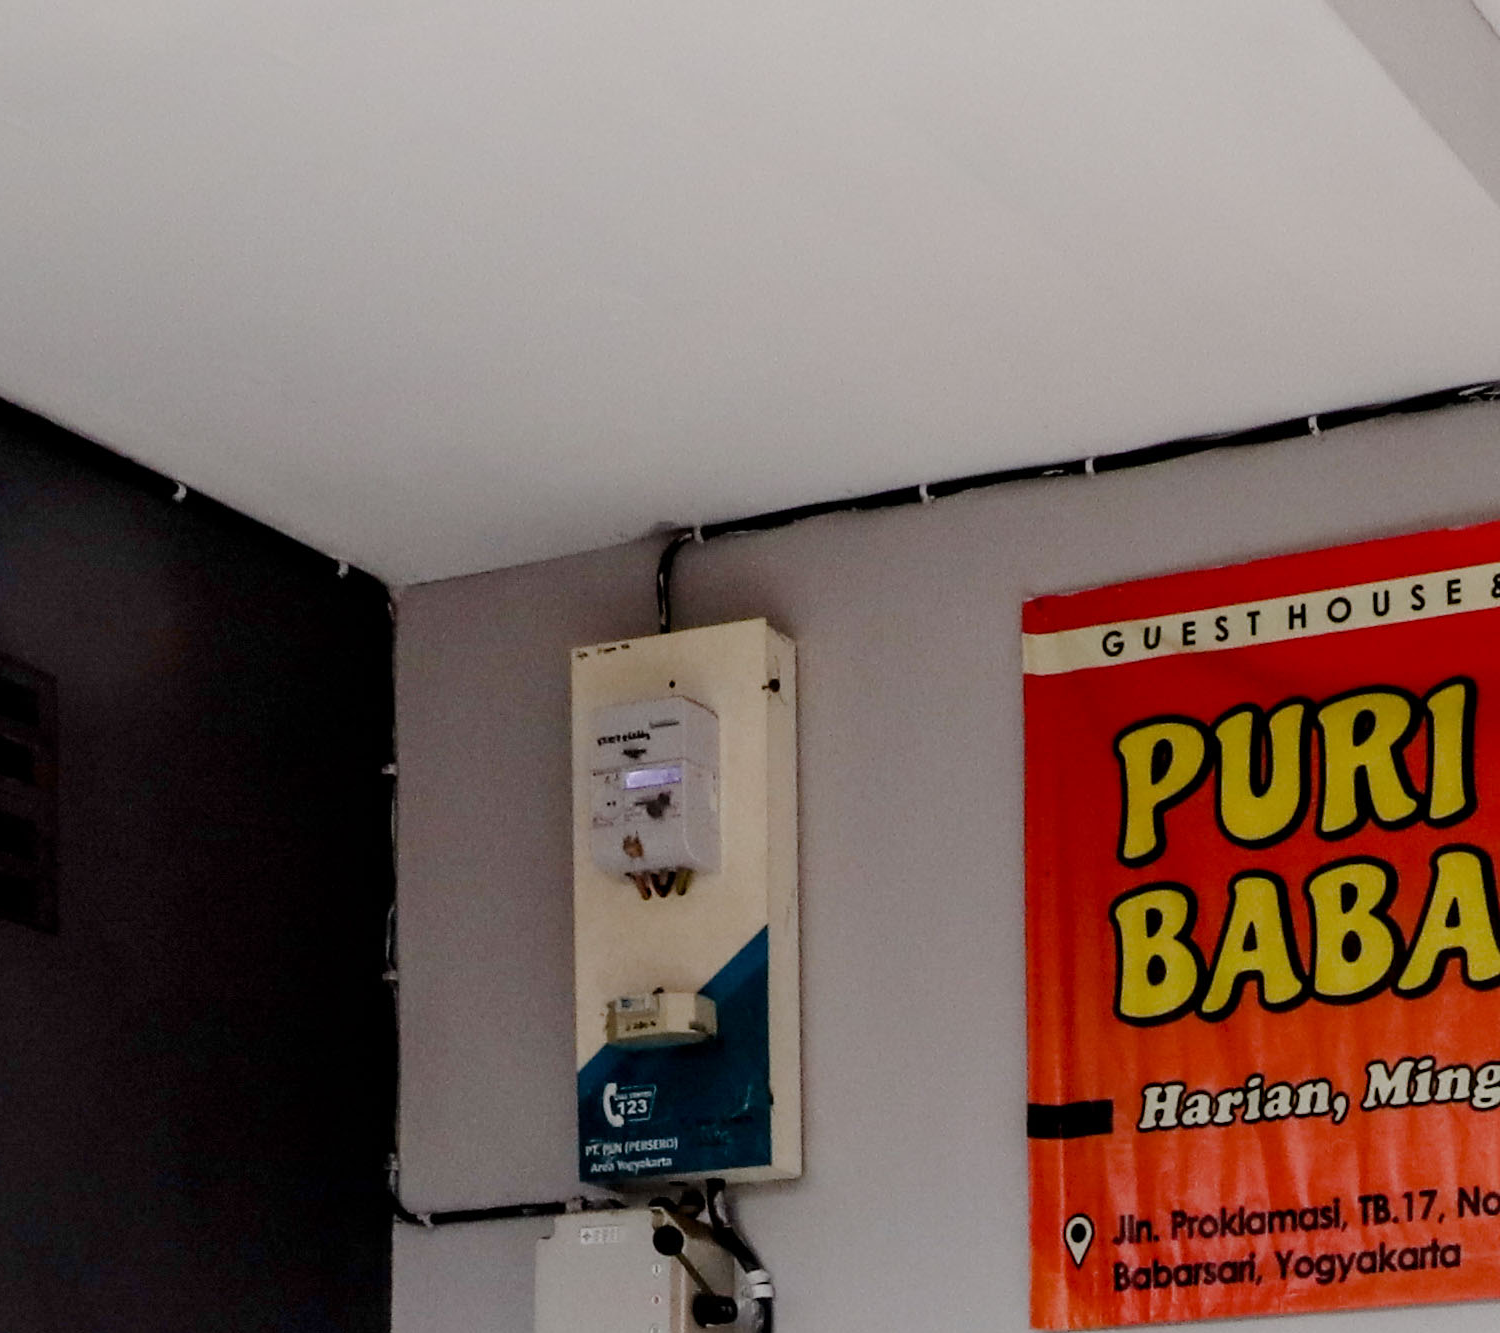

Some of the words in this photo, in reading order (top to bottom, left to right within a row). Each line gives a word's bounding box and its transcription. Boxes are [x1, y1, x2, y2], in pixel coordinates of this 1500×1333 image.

[1101, 610, 1261, 658] GUEST
[1288, 578, 1462, 631] HOUSE
[1111, 677, 1480, 867] PURI
[617, 1099, 648, 1115] 123
[1136, 1074, 1348, 1133] Harian,
[1171, 1198, 1348, 1241] Proklamasi,
[1113, 1250, 1263, 1292] Babarsari,
[1275, 1238, 1462, 1284] Yogyakarta
